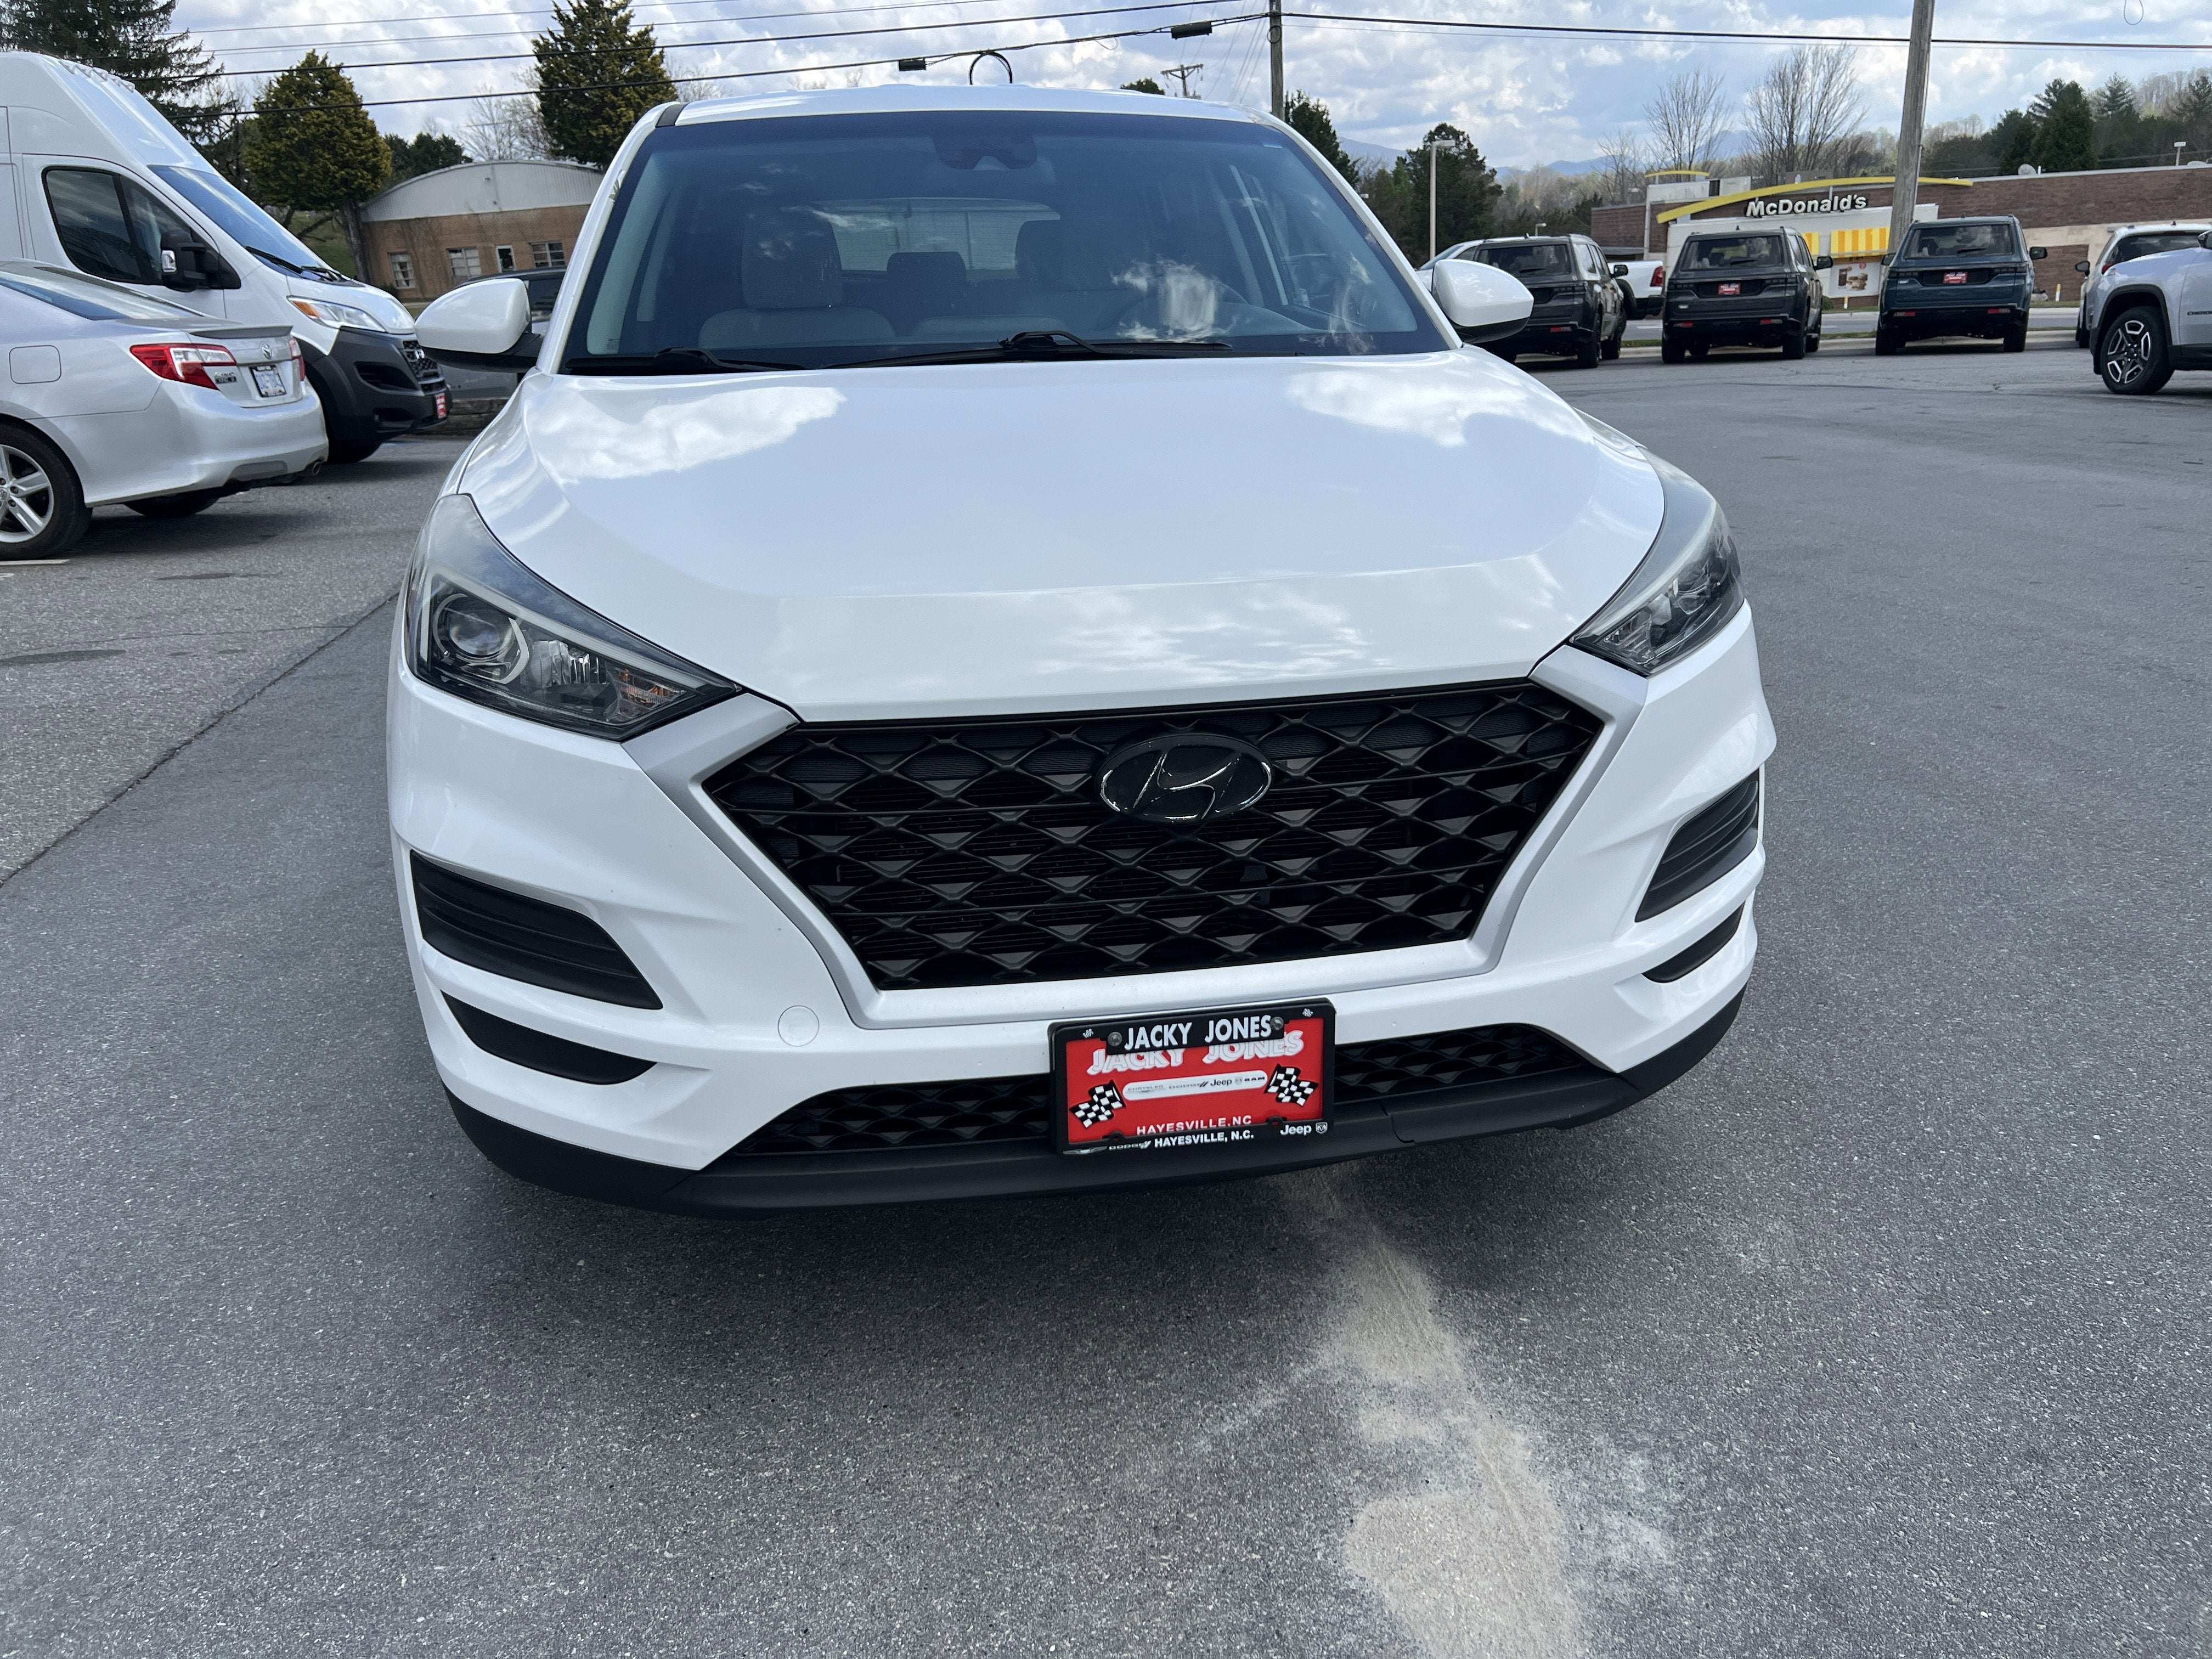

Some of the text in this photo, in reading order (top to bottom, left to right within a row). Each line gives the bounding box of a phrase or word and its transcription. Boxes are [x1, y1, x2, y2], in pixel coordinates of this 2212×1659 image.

[1746, 194, 1867, 217] McDonald's
[1125, 1015, 1272, 1050] JACKY JONES
[1086, 1030, 1304, 1075] JACKY JONES
[1154, 1132, 1228, 1148] HAYESVILLE,
[1231, 1130, 1254, 1141] N.C.
[1280, 1125, 1312, 1136] Jeep
